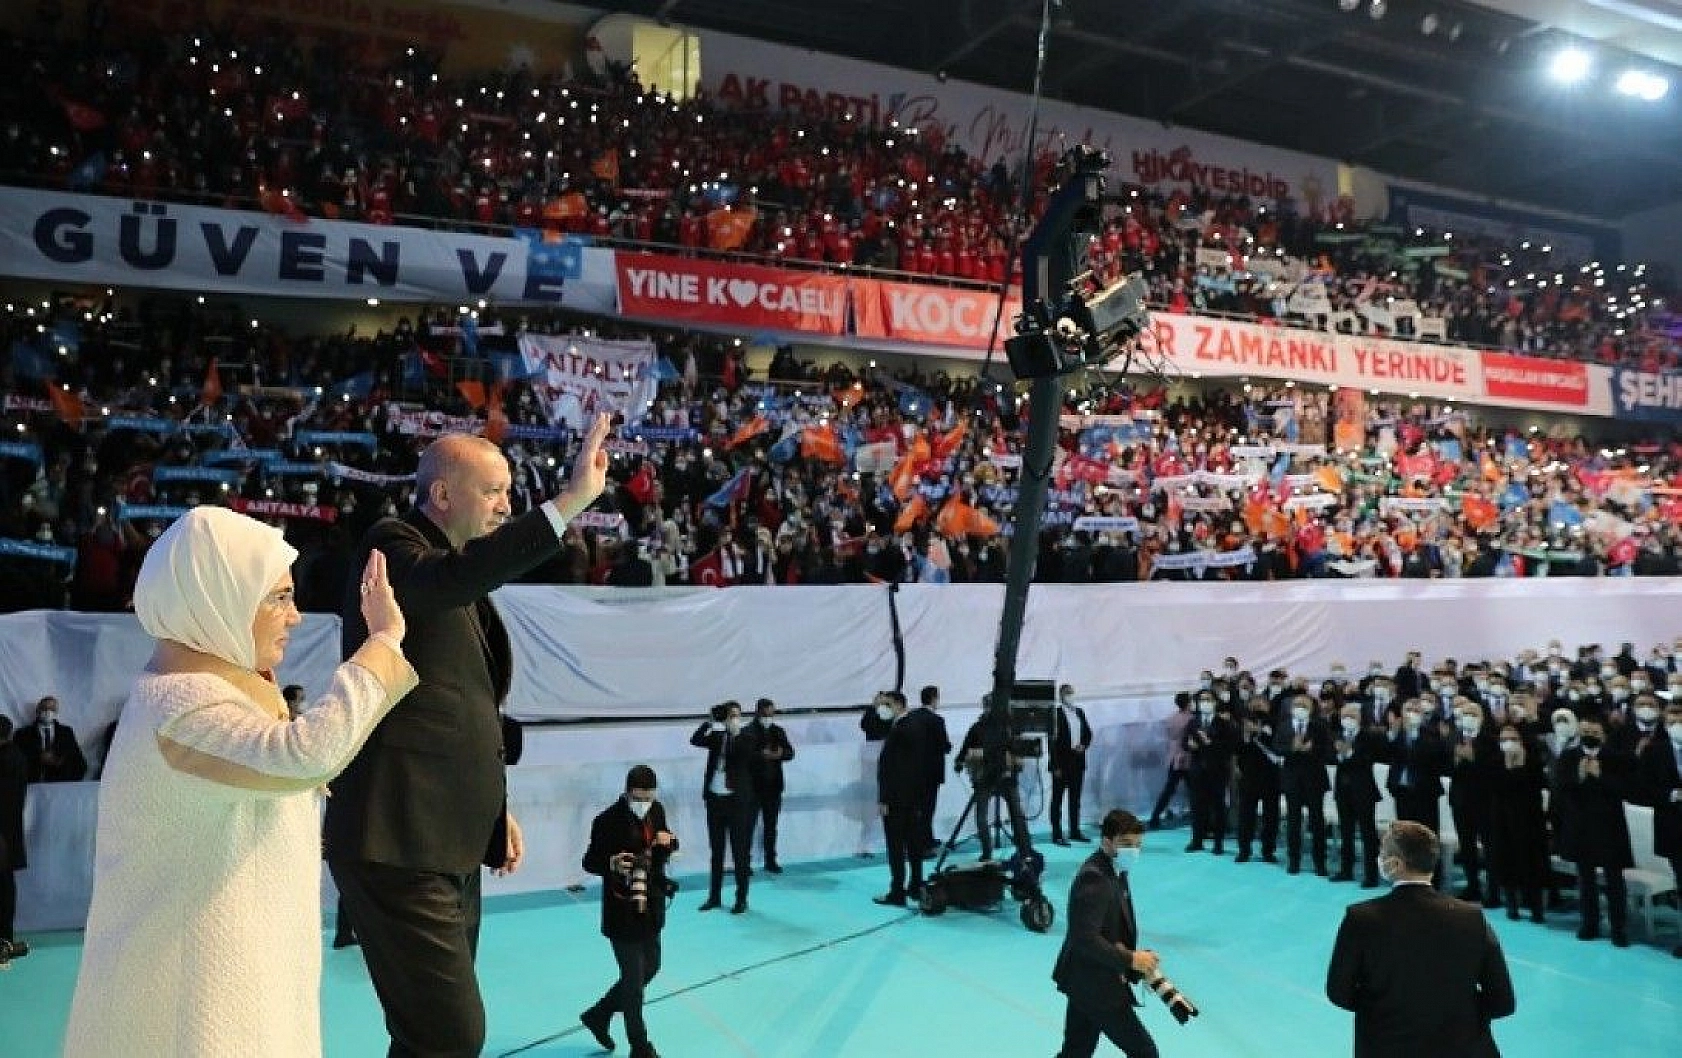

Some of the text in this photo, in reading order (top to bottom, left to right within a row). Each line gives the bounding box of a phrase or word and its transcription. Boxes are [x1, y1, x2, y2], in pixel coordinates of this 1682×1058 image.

[719, 73, 769, 109] AK
[33, 202, 400, 286] GÜVEN
[245, 500, 322, 519] ANTALYA
